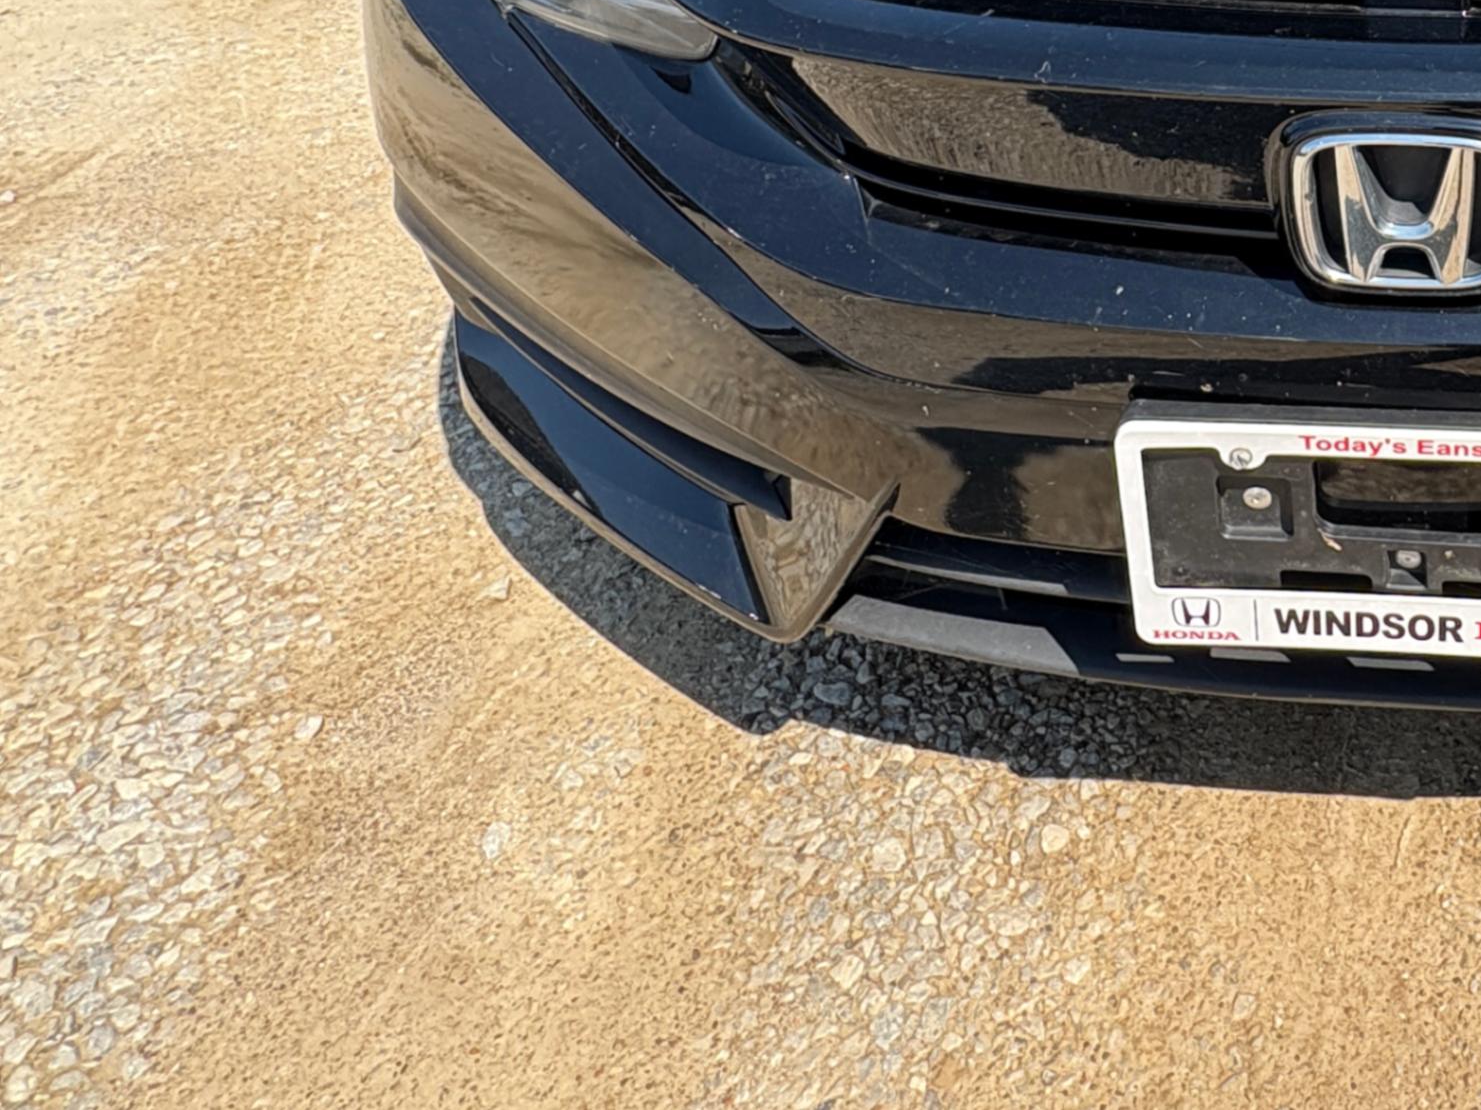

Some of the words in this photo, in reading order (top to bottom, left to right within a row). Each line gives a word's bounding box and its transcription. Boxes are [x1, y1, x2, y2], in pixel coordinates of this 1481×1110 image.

[1298, 435, 1407, 457] Today's
[1153, 629, 1242, 641] HONDA
[1274, 607, 1464, 643] WINDSOR
